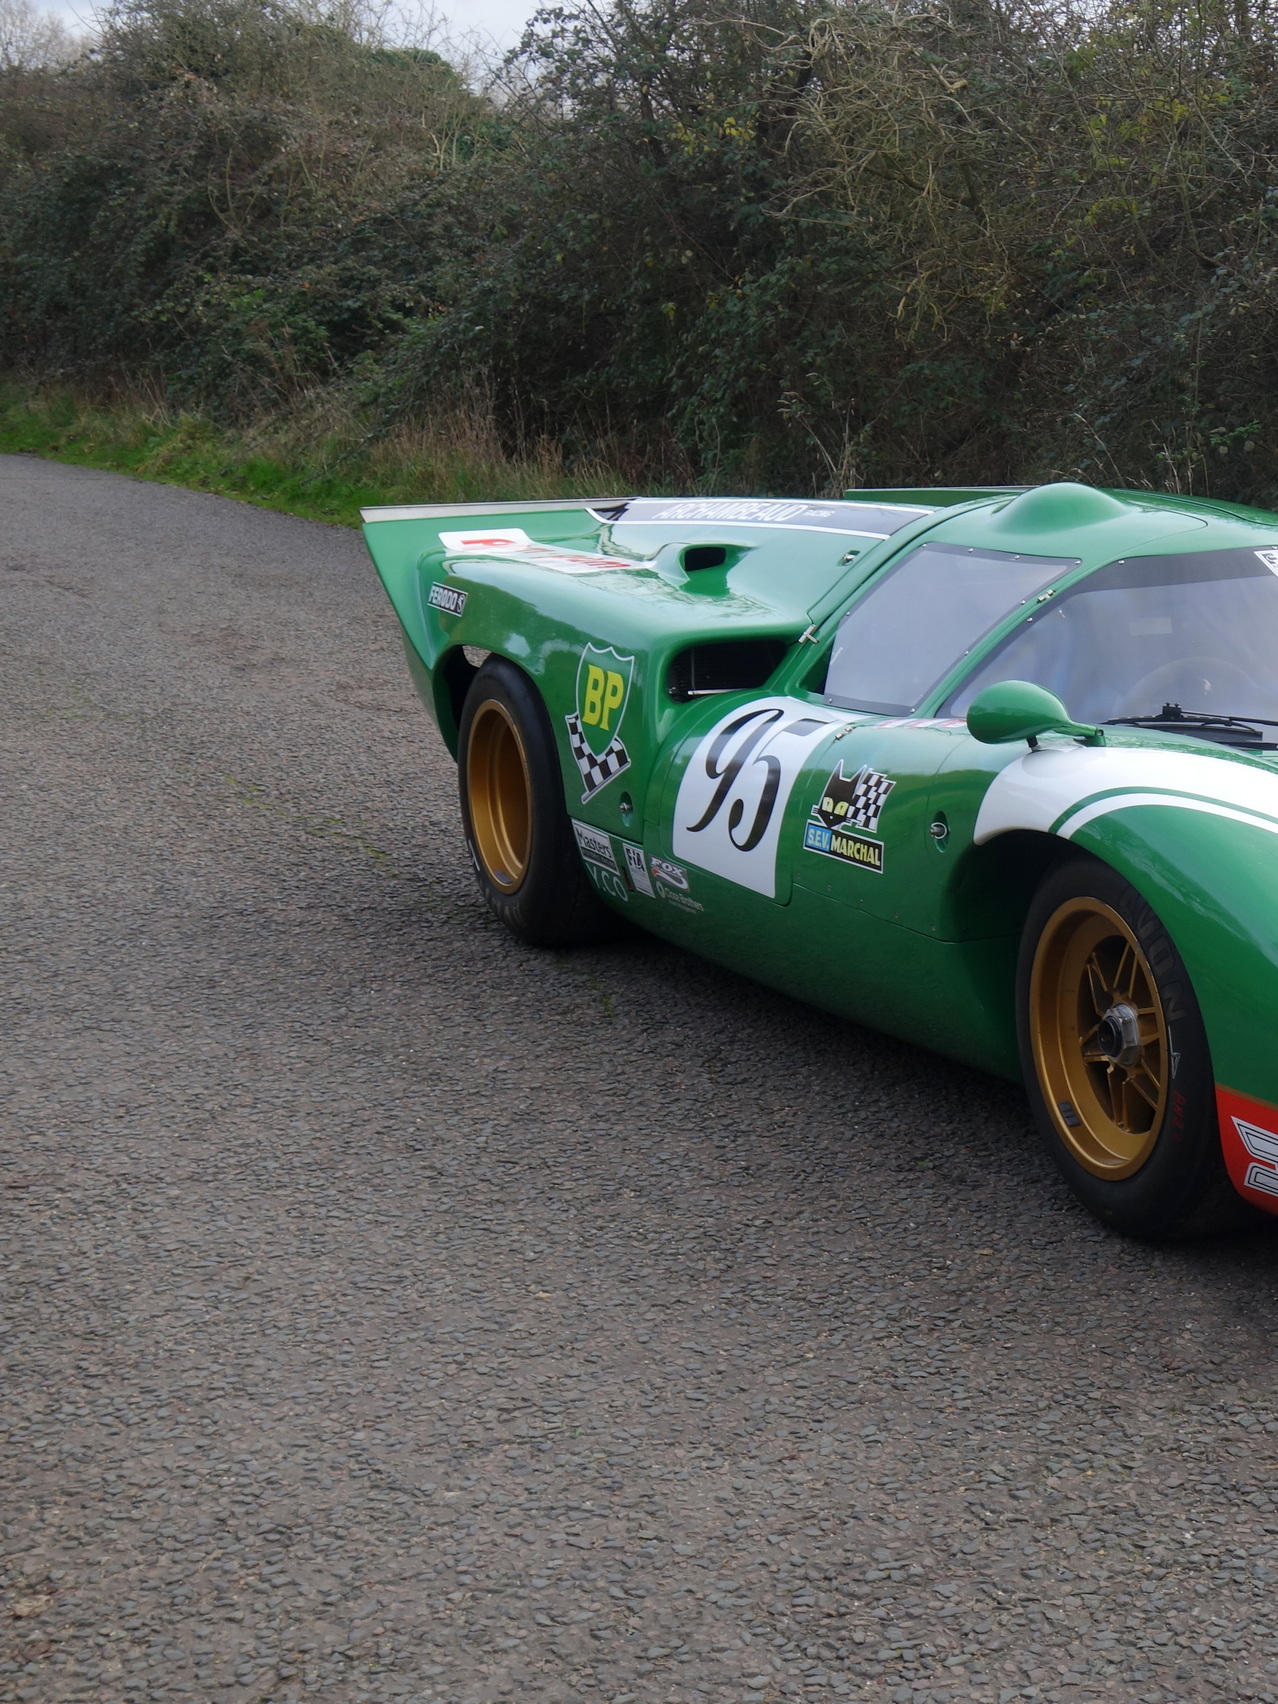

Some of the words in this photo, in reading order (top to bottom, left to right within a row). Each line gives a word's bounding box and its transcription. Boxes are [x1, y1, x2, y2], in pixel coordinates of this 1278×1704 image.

[651, 502, 809, 521] ARCHAMBEAUD
[428, 586, 458, 611] FERODO
[582, 664, 624, 731] BP
[686, 708, 832, 852] 95
[575, 827, 612, 859] Masters
[831, 834, 880, 867] MARCHAL
[650, 856, 683, 877] FOX
